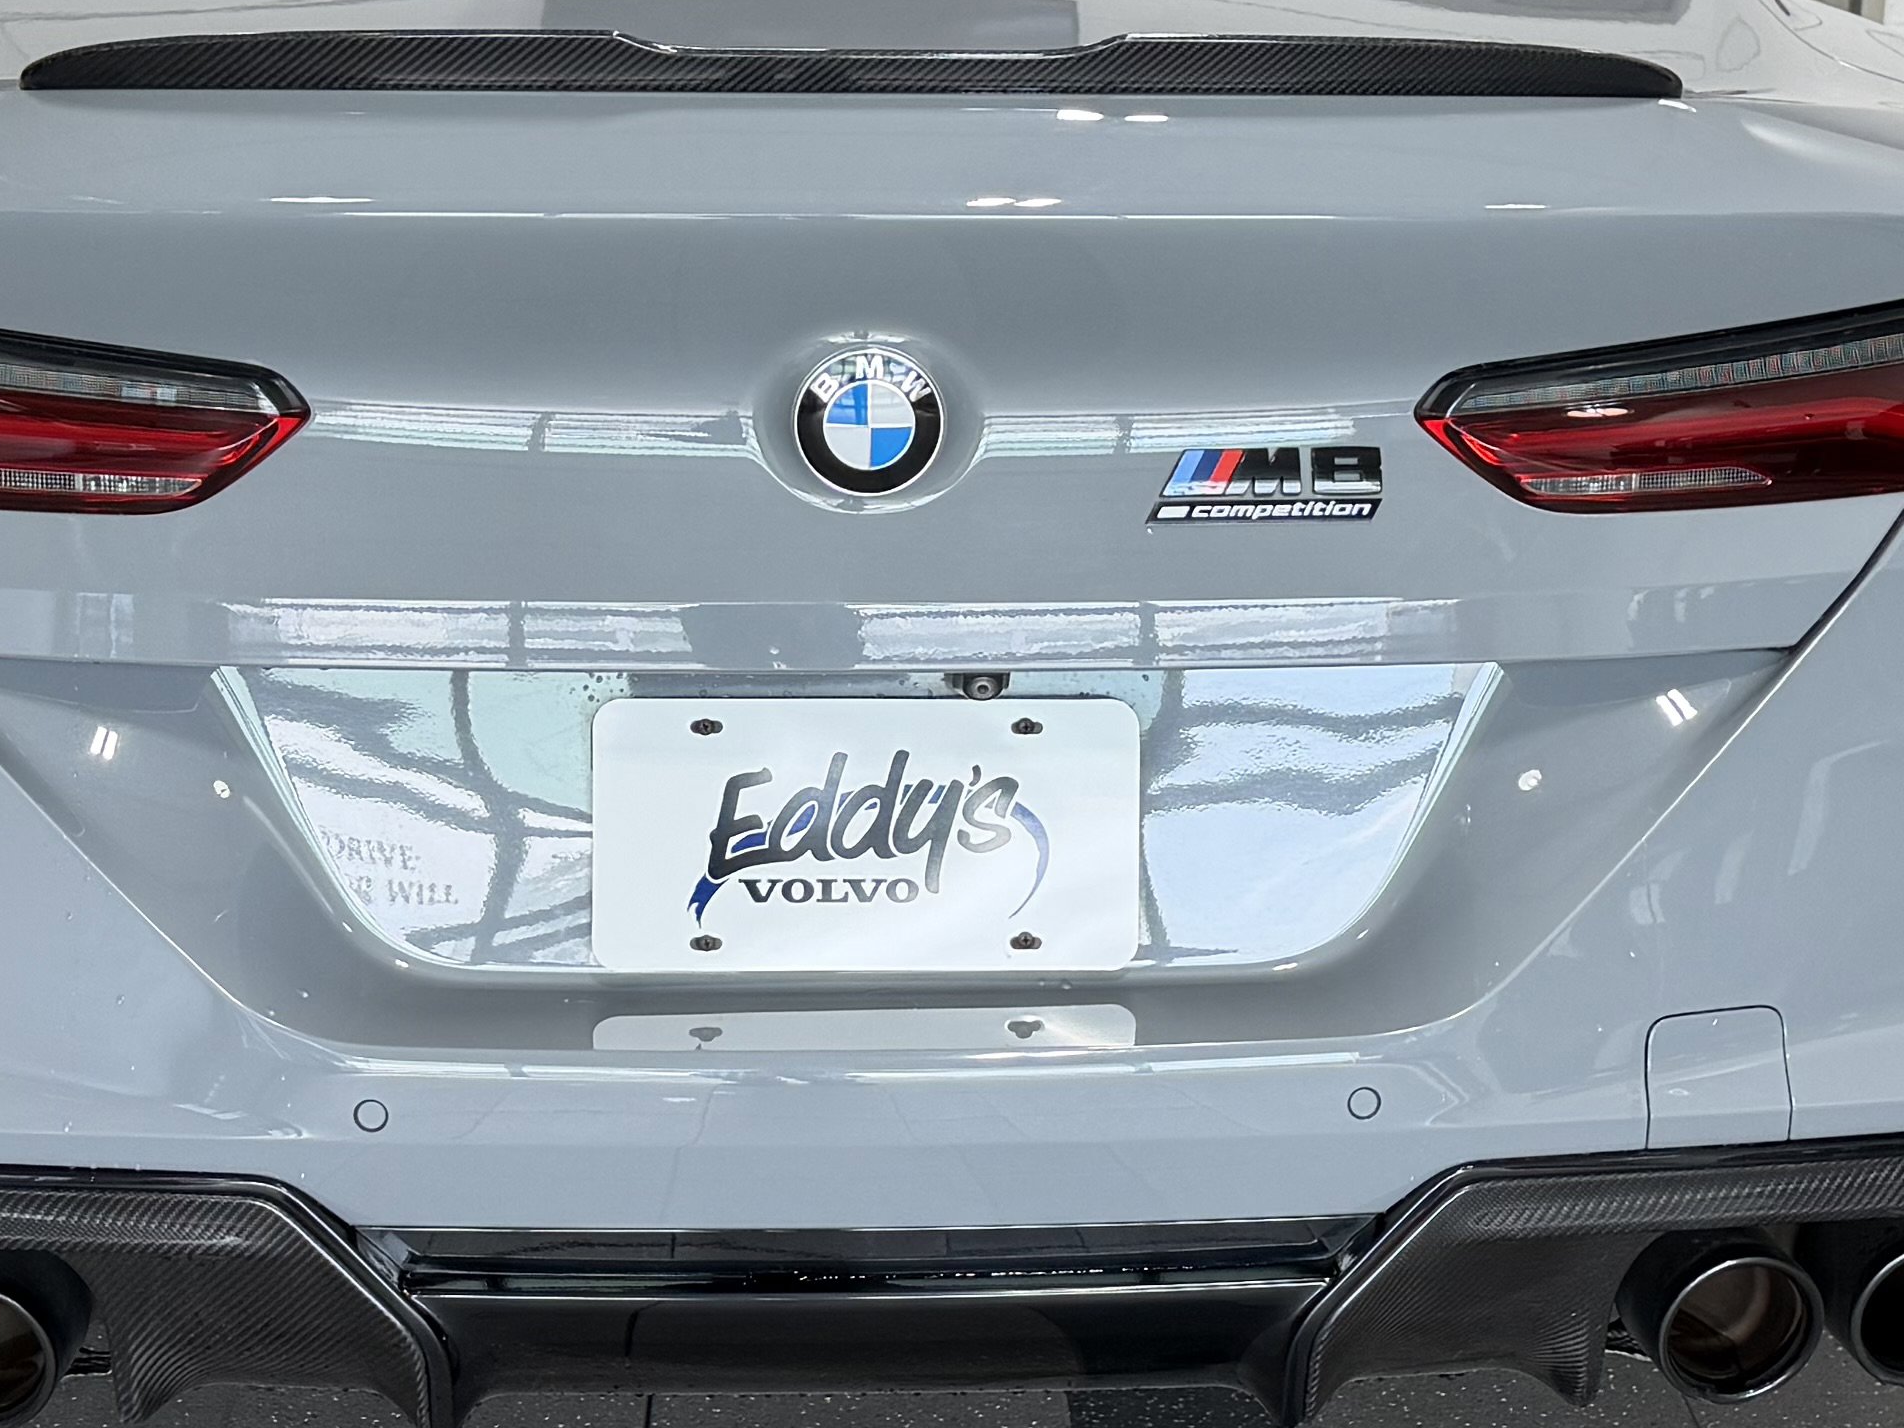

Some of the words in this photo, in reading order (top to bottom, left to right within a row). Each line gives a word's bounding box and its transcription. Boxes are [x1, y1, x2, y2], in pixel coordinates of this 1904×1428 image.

[809, 353, 935, 403] BMW
[1216, 446, 1385, 498] M8
[1191, 499, 1373, 522] competition
[707, 749, 1024, 894] Eddy's
[738, 878, 920, 904] VOLVO
